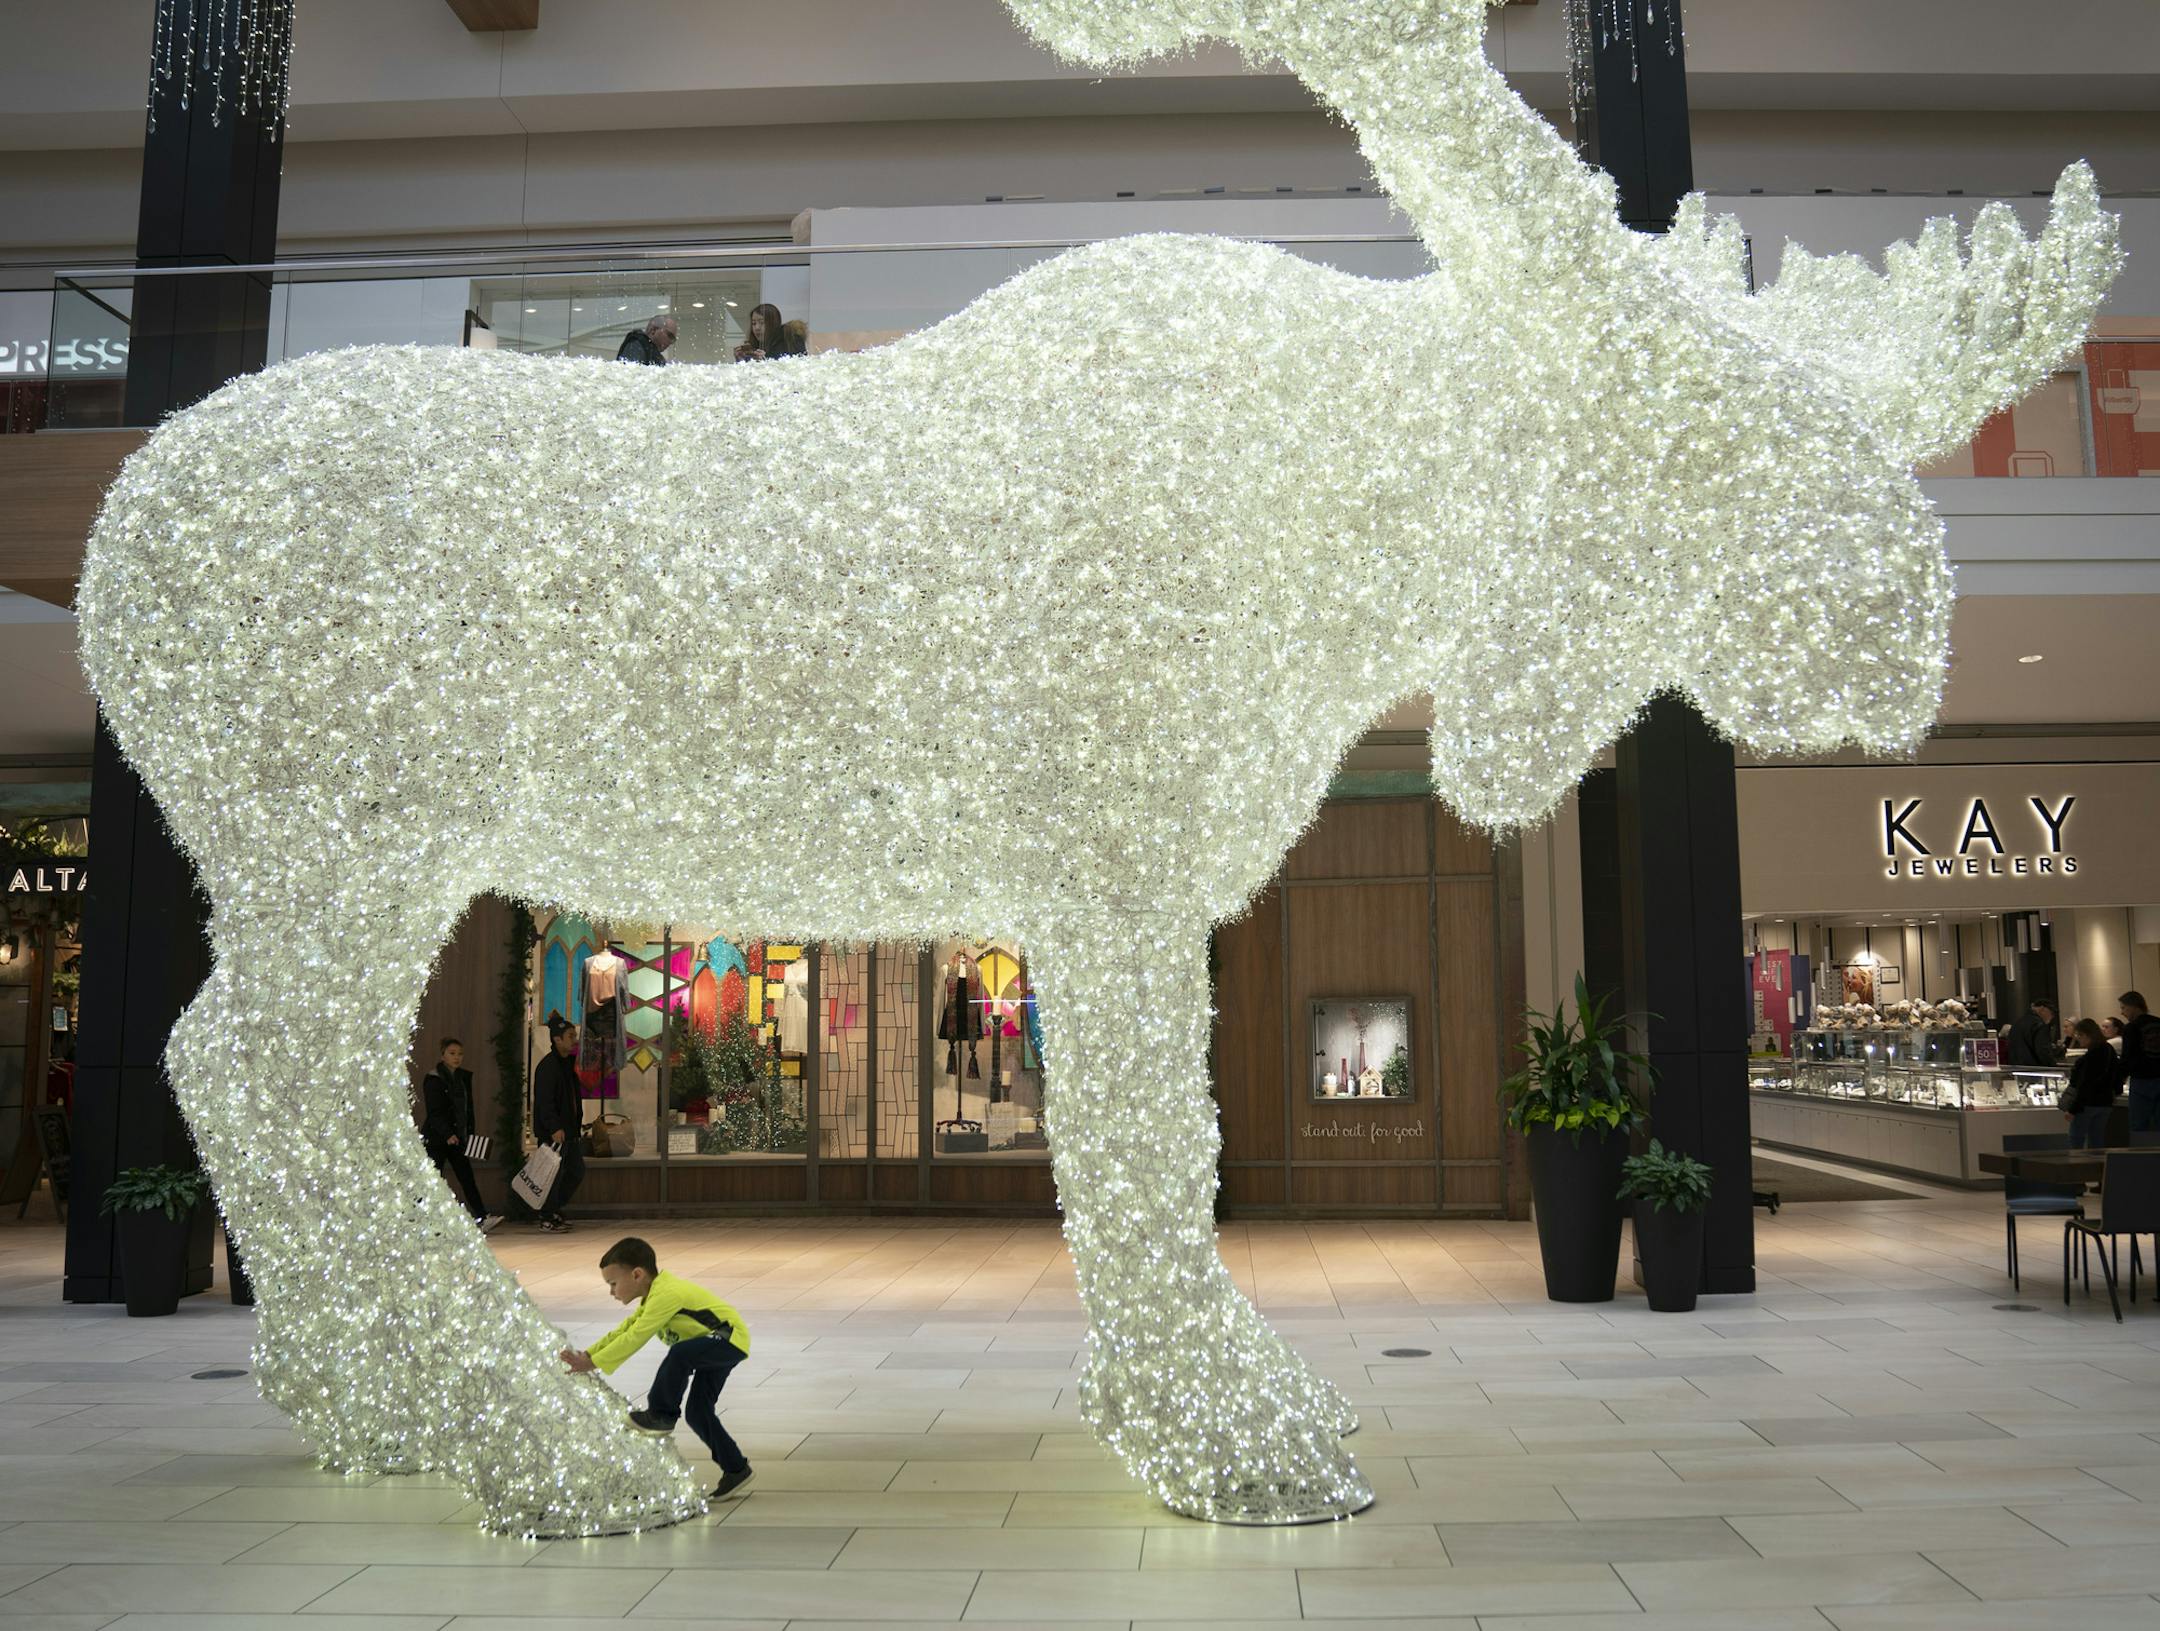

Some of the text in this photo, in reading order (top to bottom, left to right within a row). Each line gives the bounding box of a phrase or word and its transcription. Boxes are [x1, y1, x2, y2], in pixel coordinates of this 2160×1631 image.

[0, 339, 129, 372] PRESS
[1883, 797, 2076, 855] KAY
[1887, 857, 2078, 875] JEWELERS
[1301, 1120, 1339, 1137] stand
[1371, 1121, 1392, 1144] for
